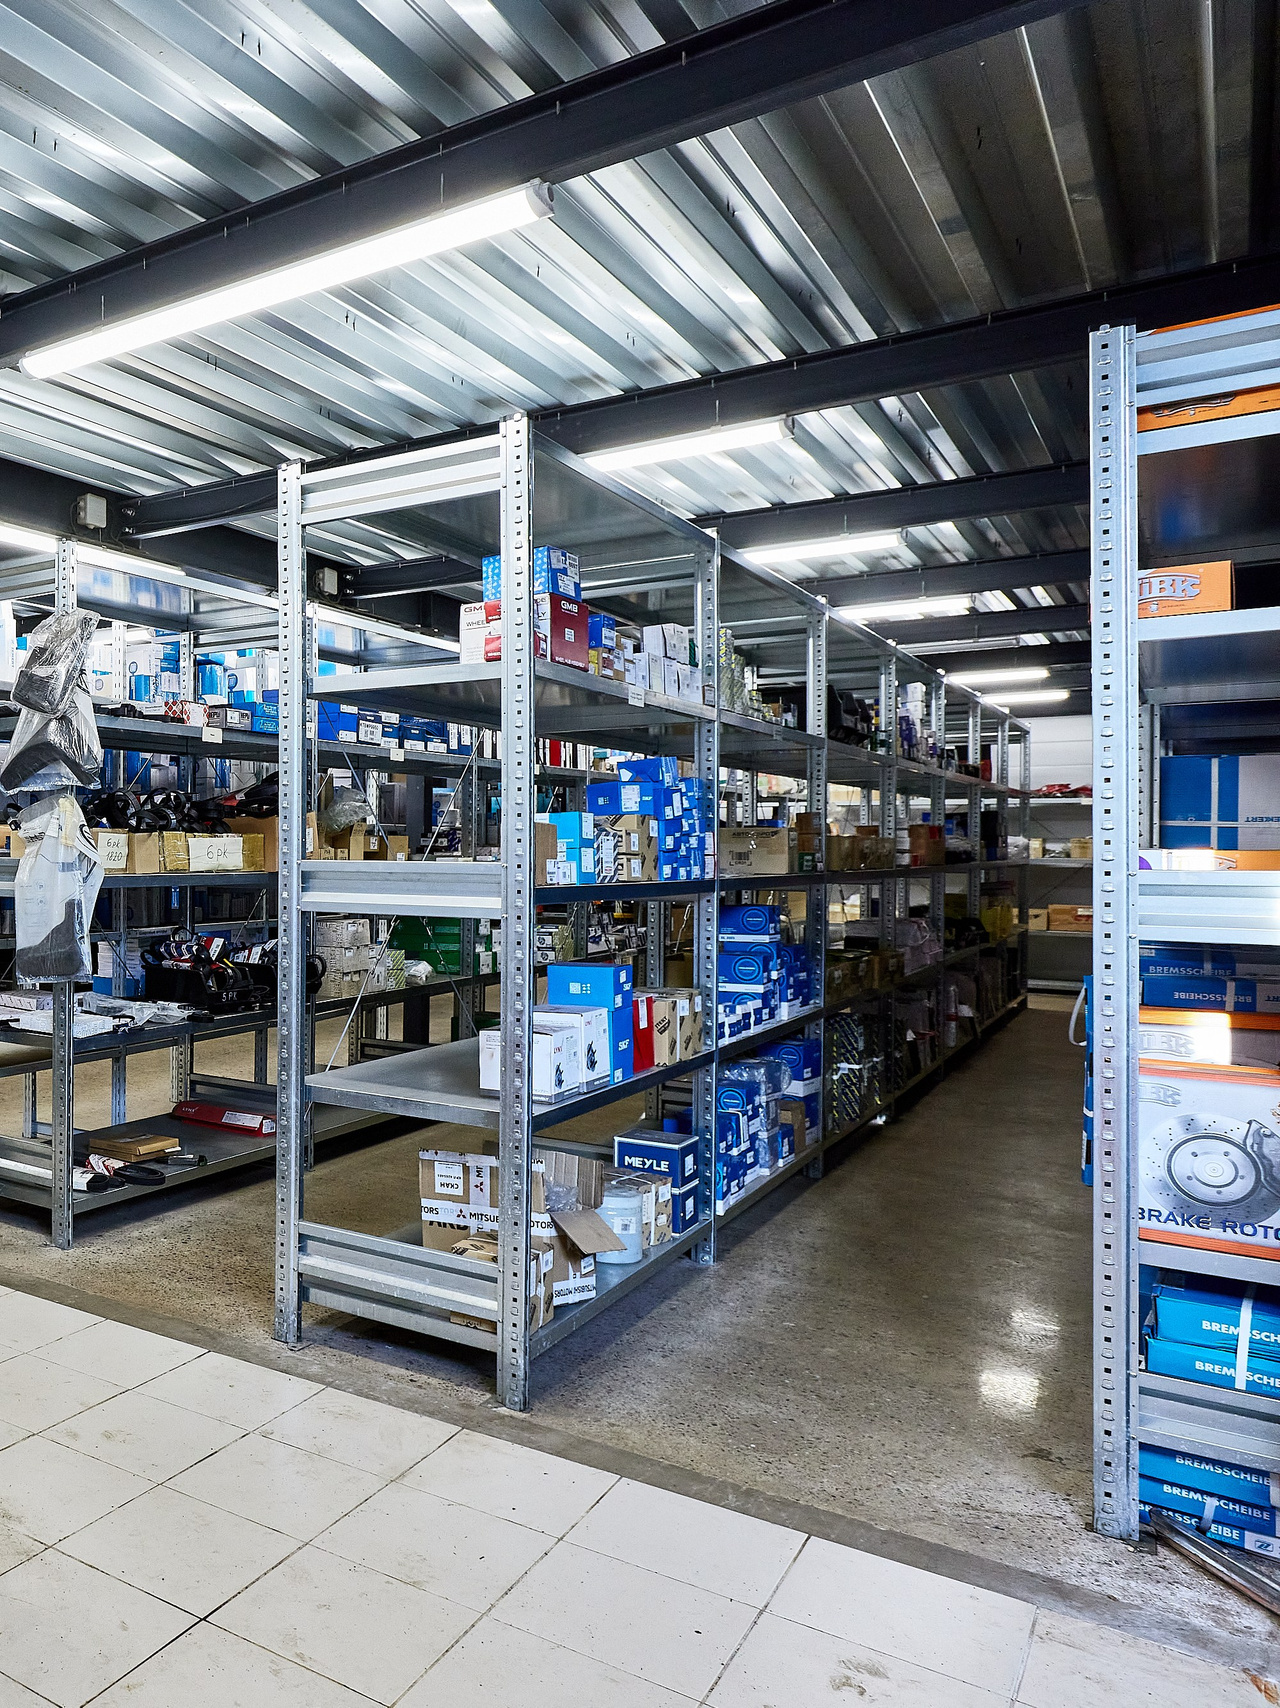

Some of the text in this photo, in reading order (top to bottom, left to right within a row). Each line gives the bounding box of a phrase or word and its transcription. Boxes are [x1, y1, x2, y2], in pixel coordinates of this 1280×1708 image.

[561, 601, 578, 612] GMB
[106, 851, 123, 862] 1820
[618, 1039, 629, 1050] SKF
[624, 1155, 669, 1172] MEYLE
[1138, 1207, 1212, 1230] BRAKE
